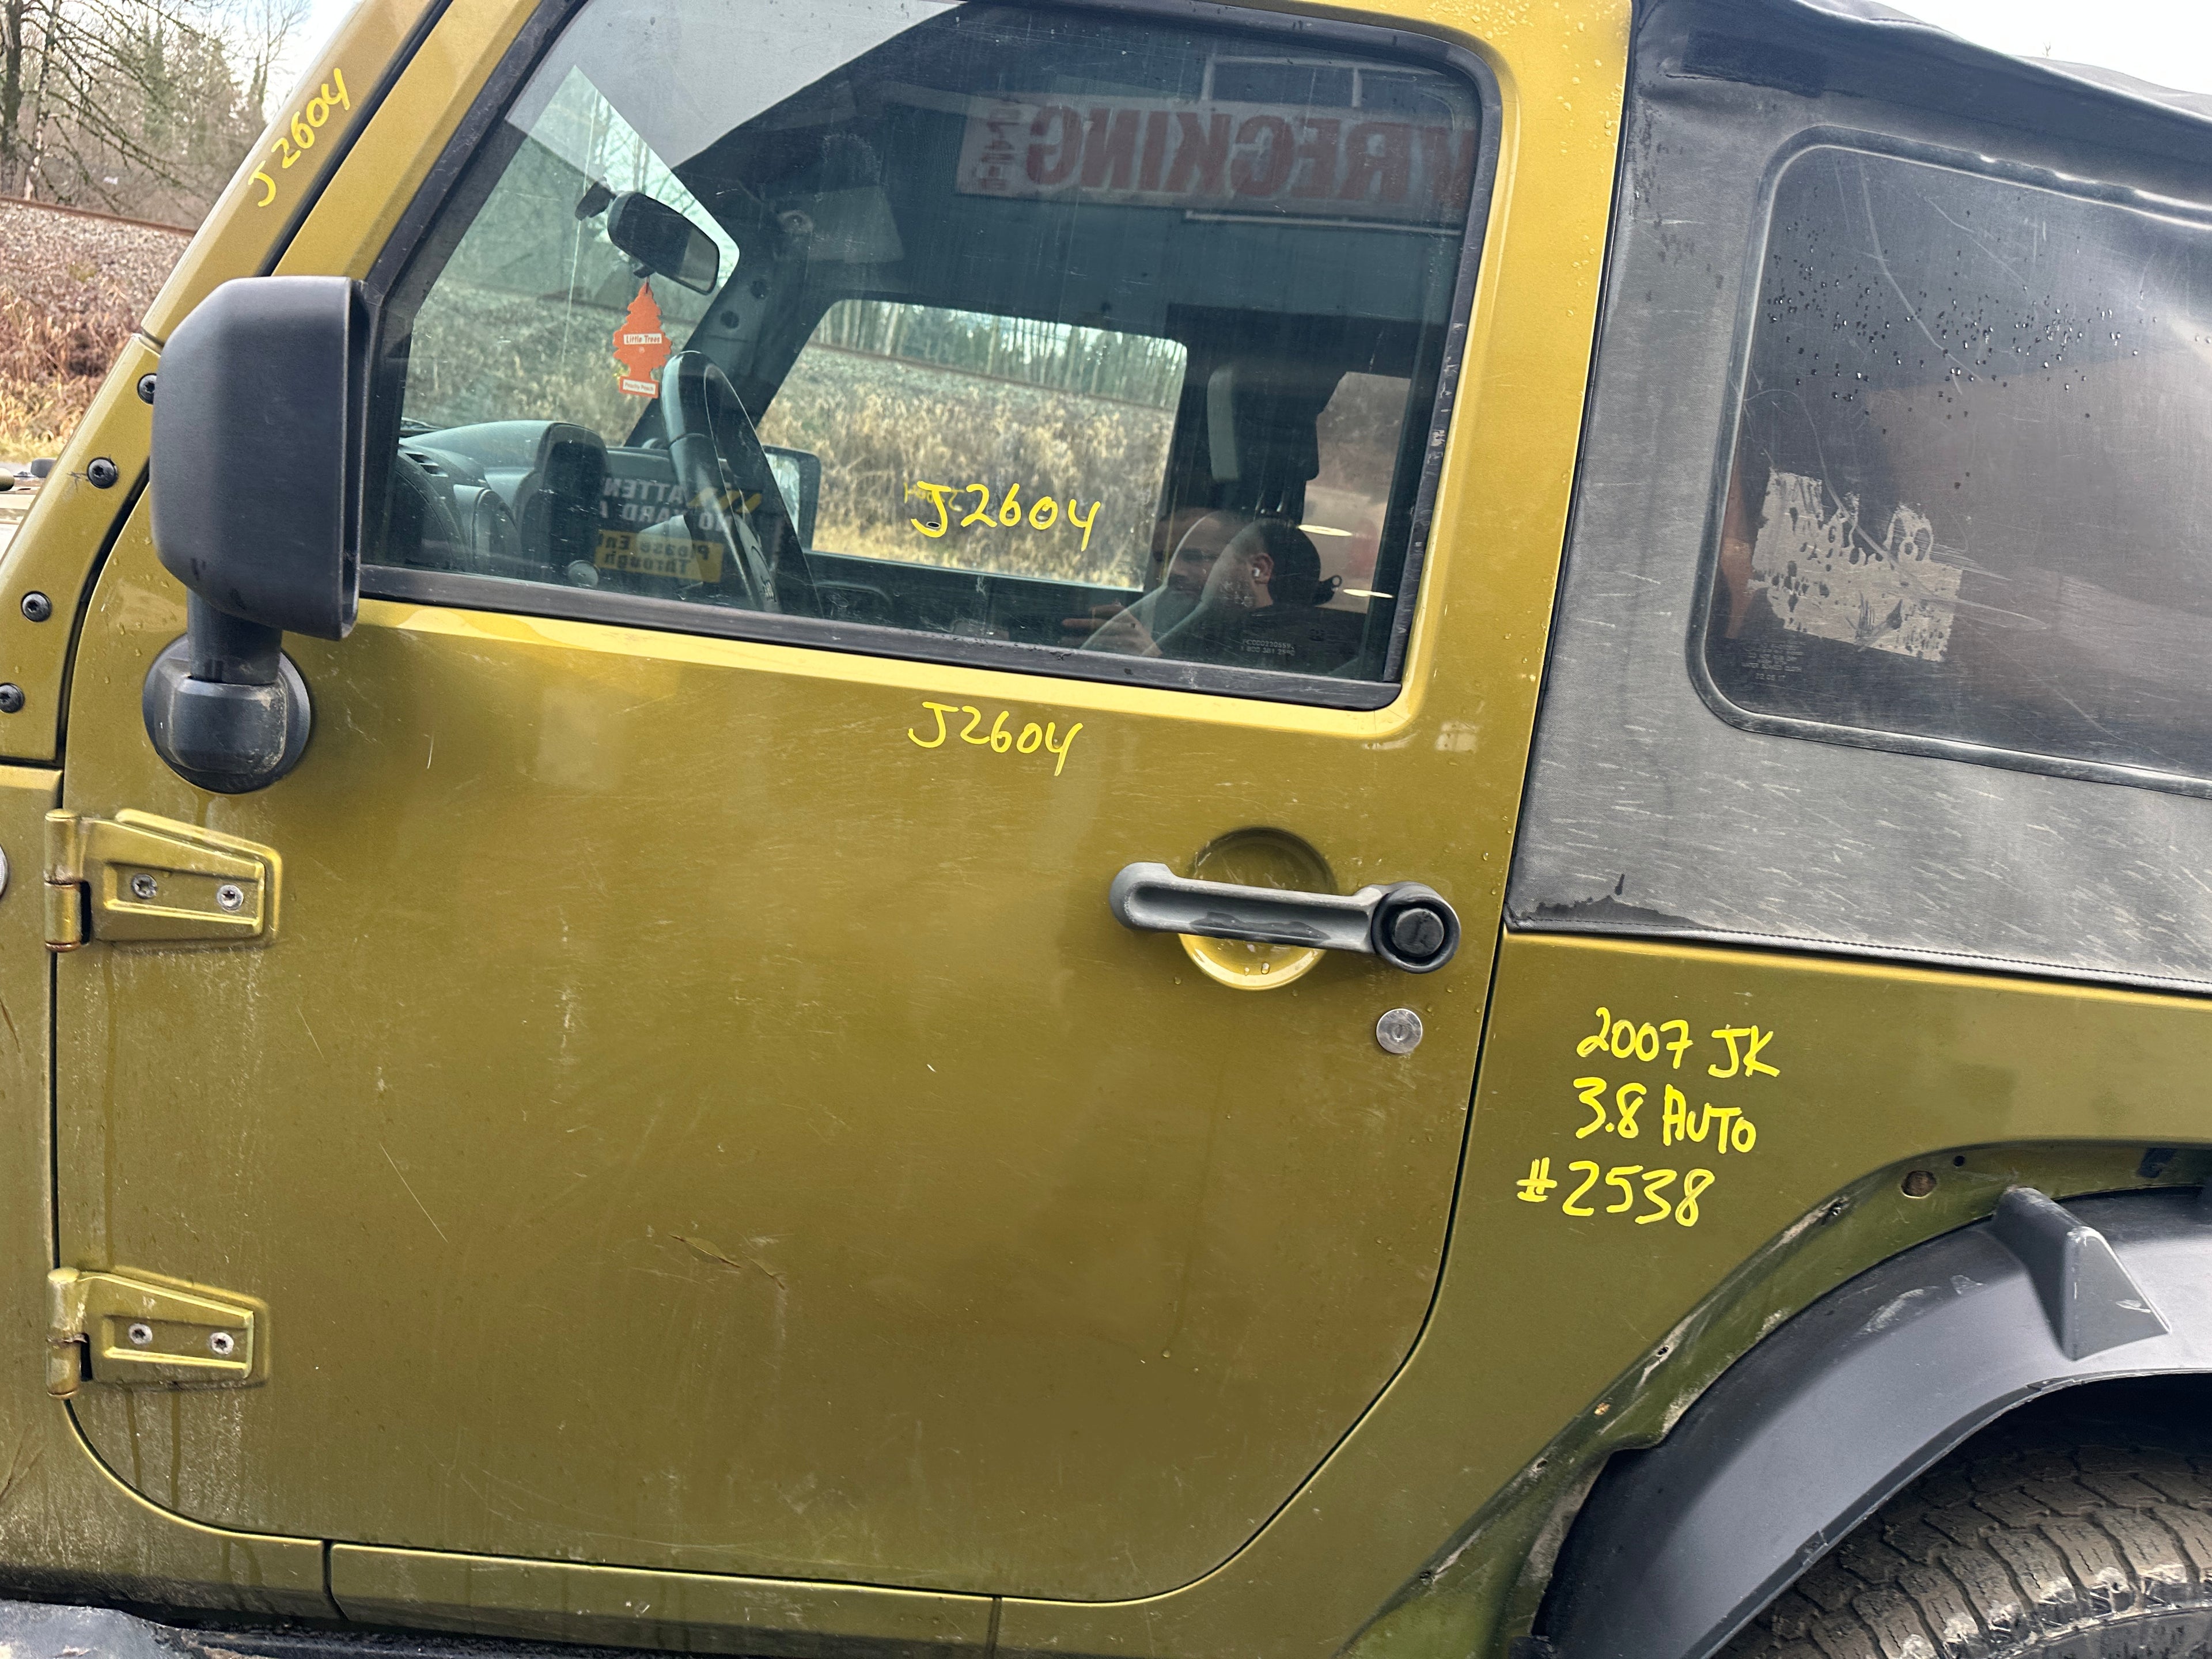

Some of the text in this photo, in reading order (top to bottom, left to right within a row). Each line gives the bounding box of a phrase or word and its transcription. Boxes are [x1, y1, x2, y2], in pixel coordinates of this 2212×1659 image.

[626, 335, 660, 344] Little Trees
[911, 480, 1101, 551] J2604
[907, 701, 1083, 777] J2604
[1577, 1007, 1780, 1078] 2007 JK
[1573, 1077, 1756, 1154] 3.8 AUTO
[1516, 1157, 1715, 1227] #2538
